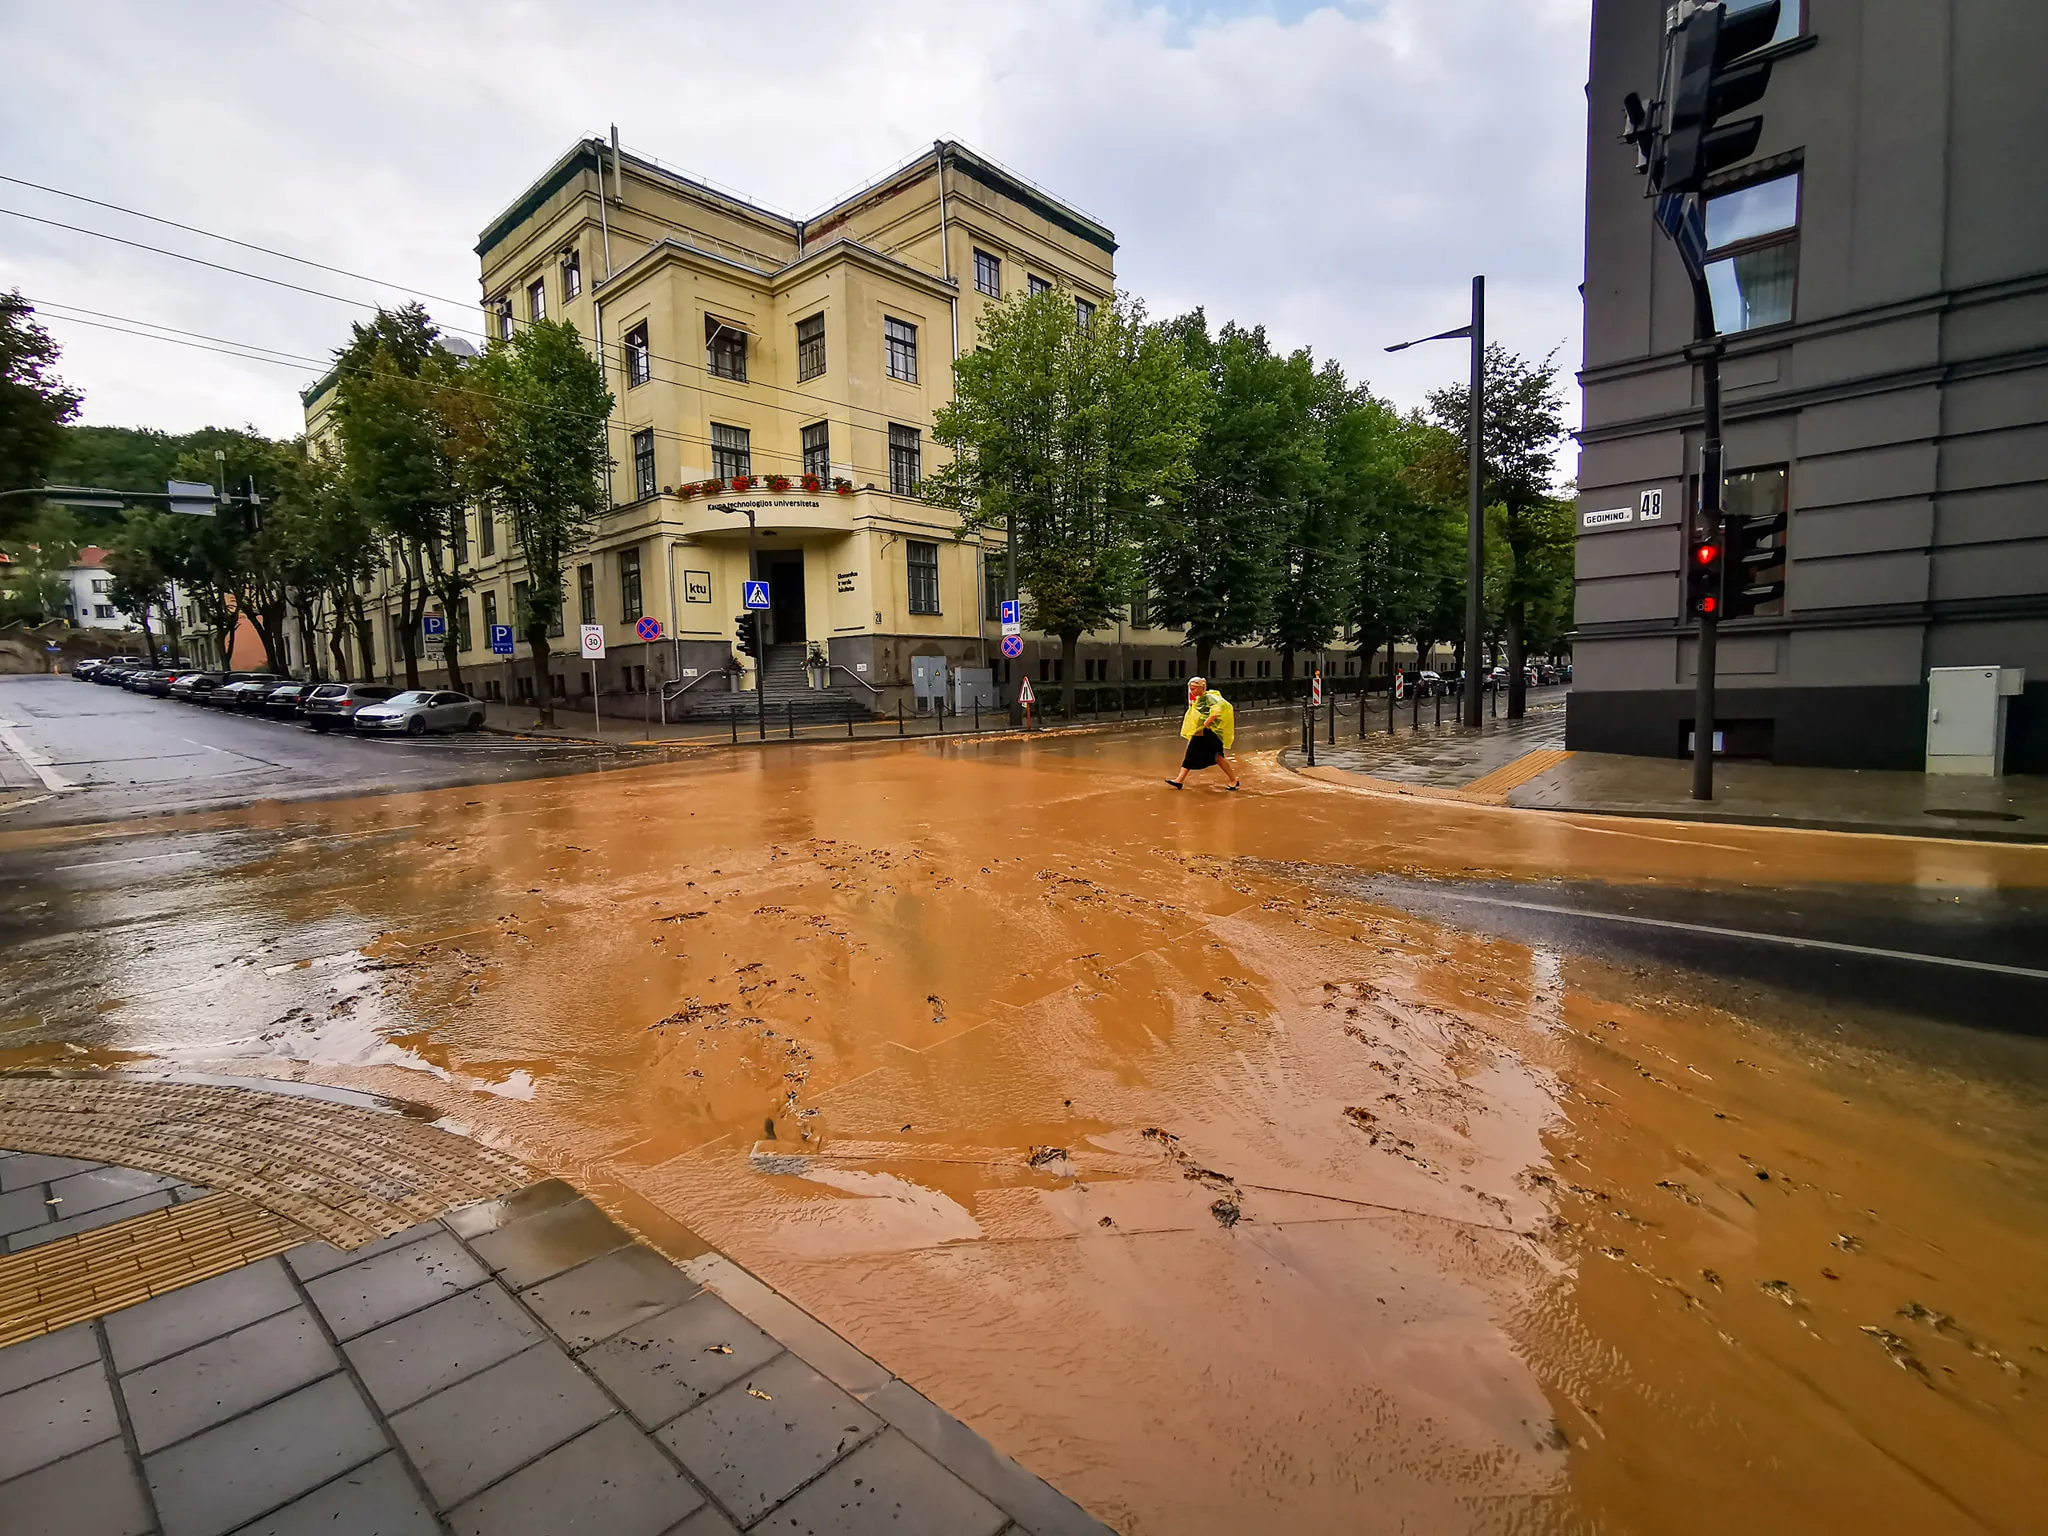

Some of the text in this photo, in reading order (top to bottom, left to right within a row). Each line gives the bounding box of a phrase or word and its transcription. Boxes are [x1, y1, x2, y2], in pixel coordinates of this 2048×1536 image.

[773, 499, 819, 507] universitetas
[1641, 493, 1661, 516] 48
[1586, 512, 1624, 524] GEDIMINO
[690, 583, 706, 594] ktu
[429, 618, 441, 633] P
[495, 626, 507, 642] P
[588, 638, 598, 646] 30
